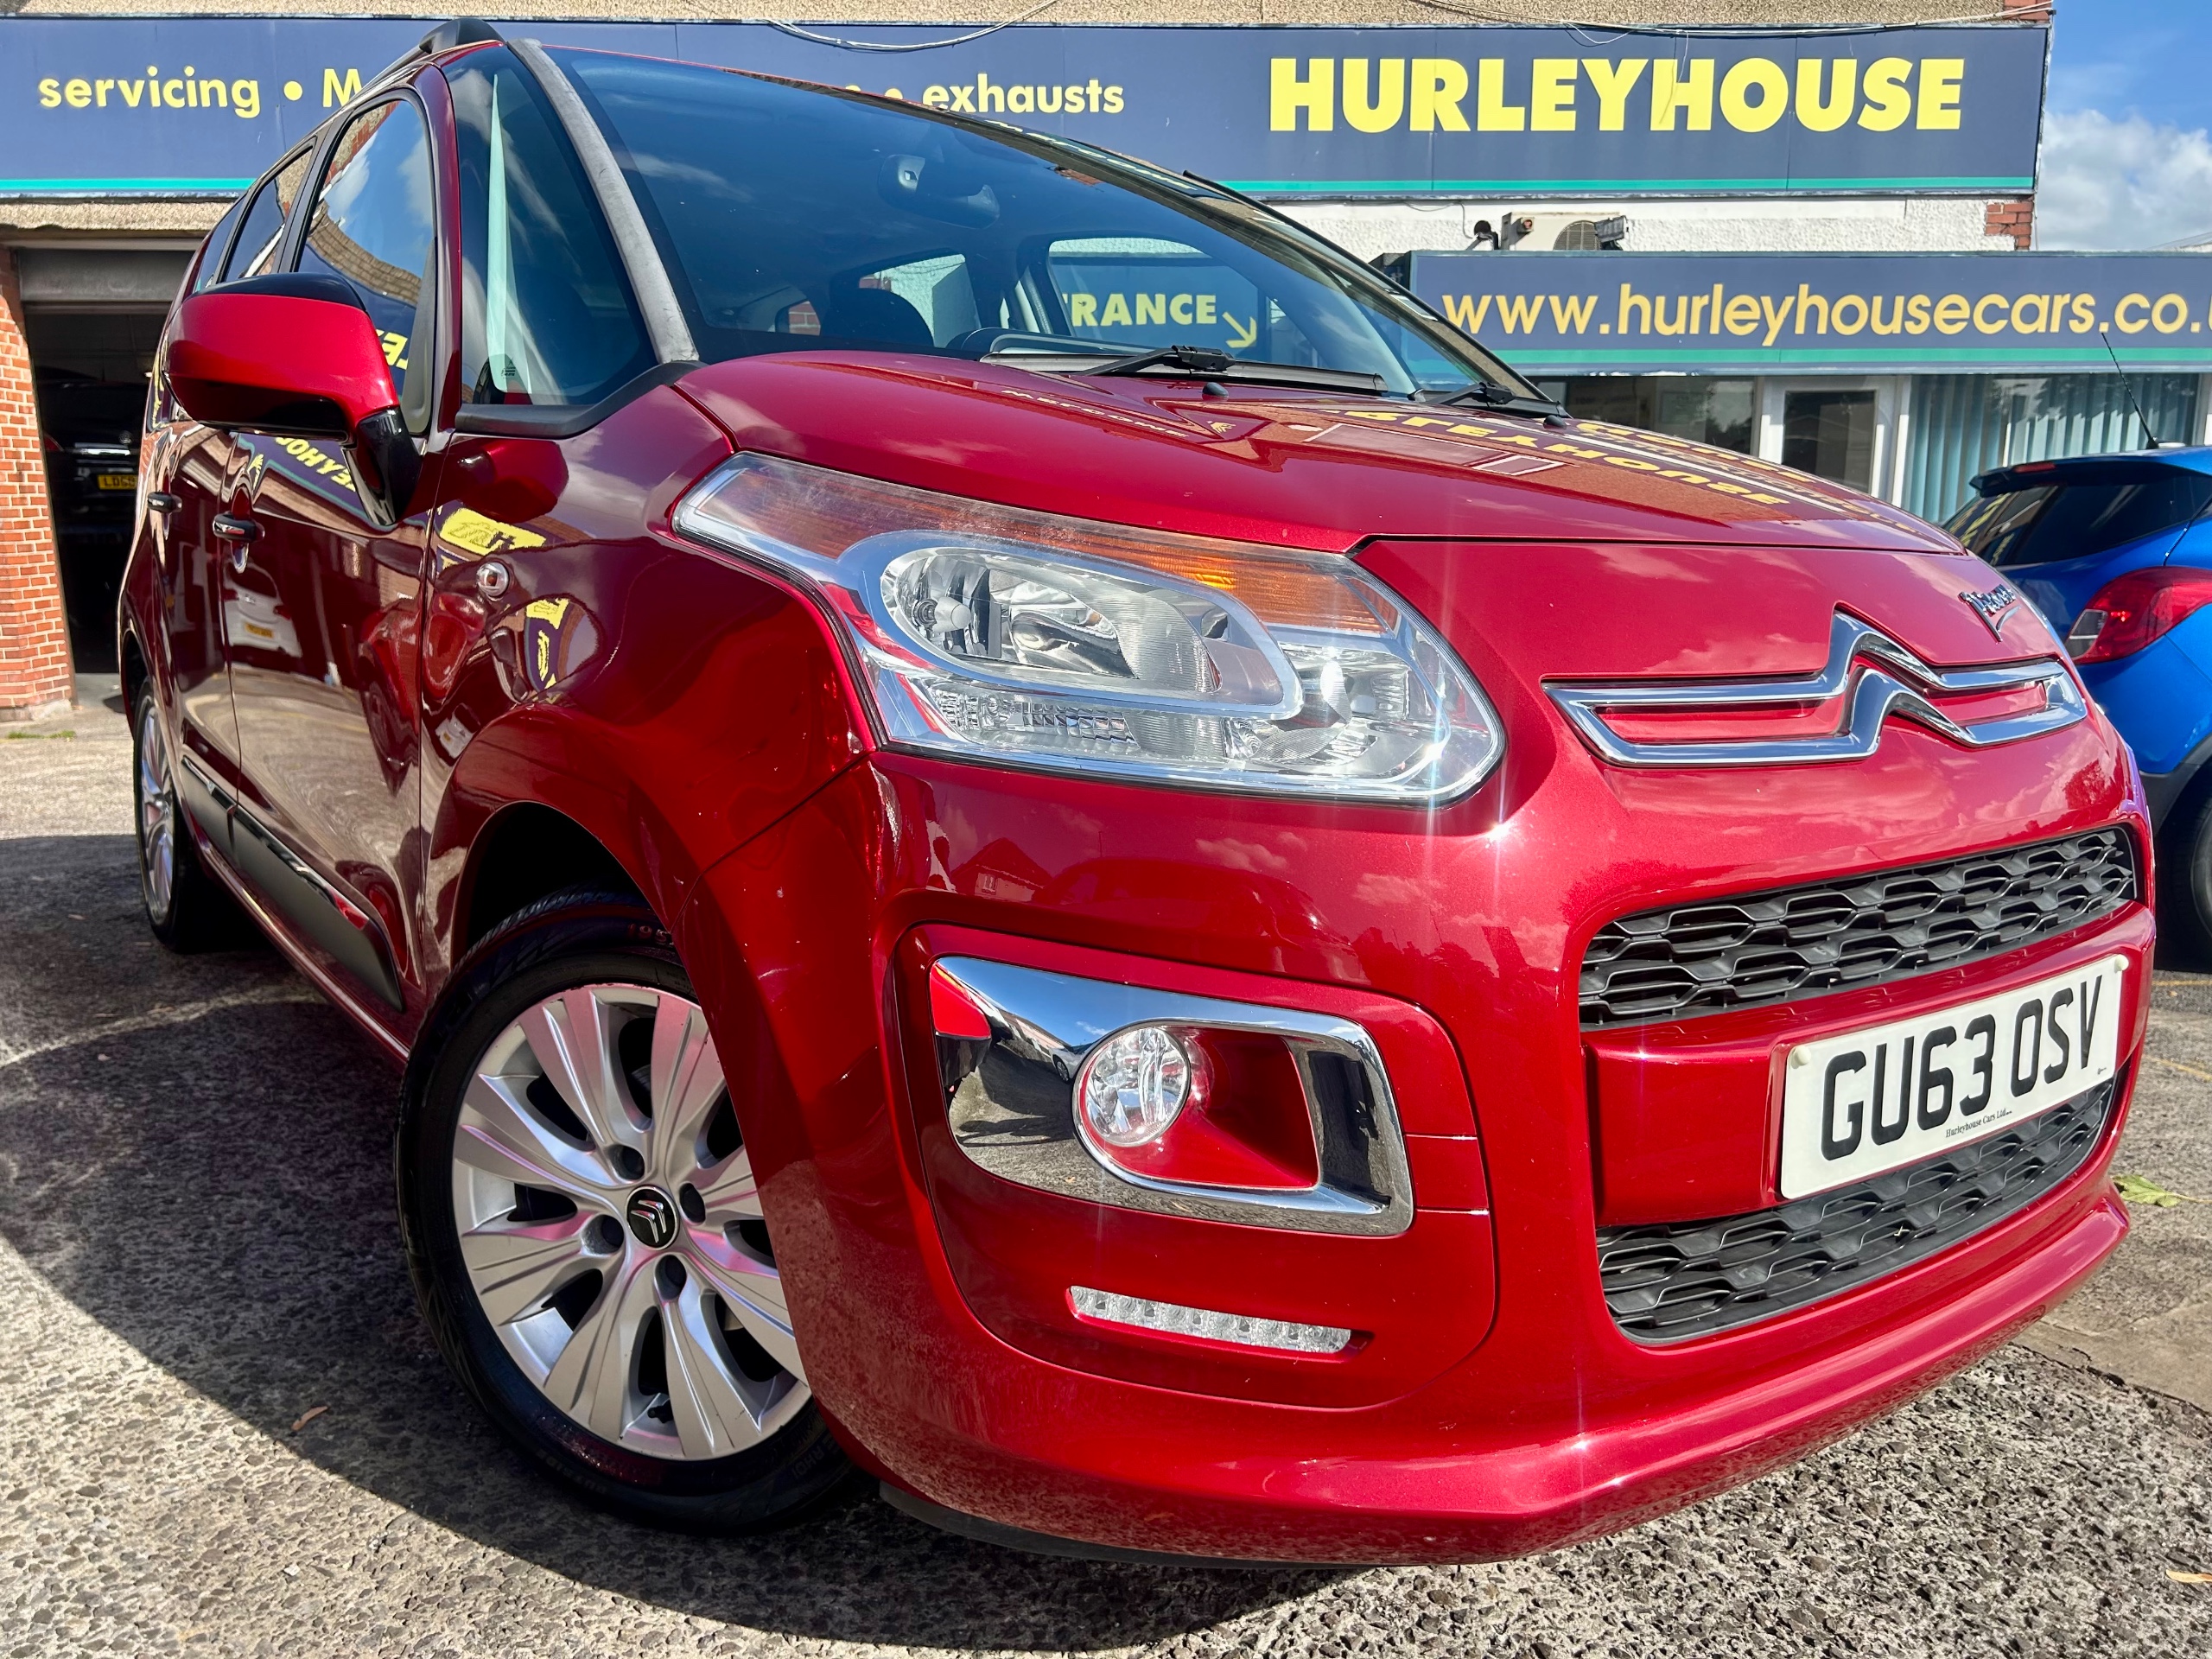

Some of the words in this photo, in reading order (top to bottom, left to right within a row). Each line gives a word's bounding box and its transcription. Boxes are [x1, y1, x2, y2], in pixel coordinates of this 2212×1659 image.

[39, 66, 261, 118] servicing
[922, 73, 1124, 113] exhausts
[1270, 57, 1966, 133] HURLEYHOUSE
[1062, 293, 1217, 327] RANCE
[1441, 283, 2212, 346] www.hurleyhousecars.co.
[1821, 1014, 1996, 1161] GU63
[2010, 974, 2103, 1098] OSV
[1945, 1118, 1982, 1138] Hurleyhouse
[1982, 1113, 1996, 1124] Cars
